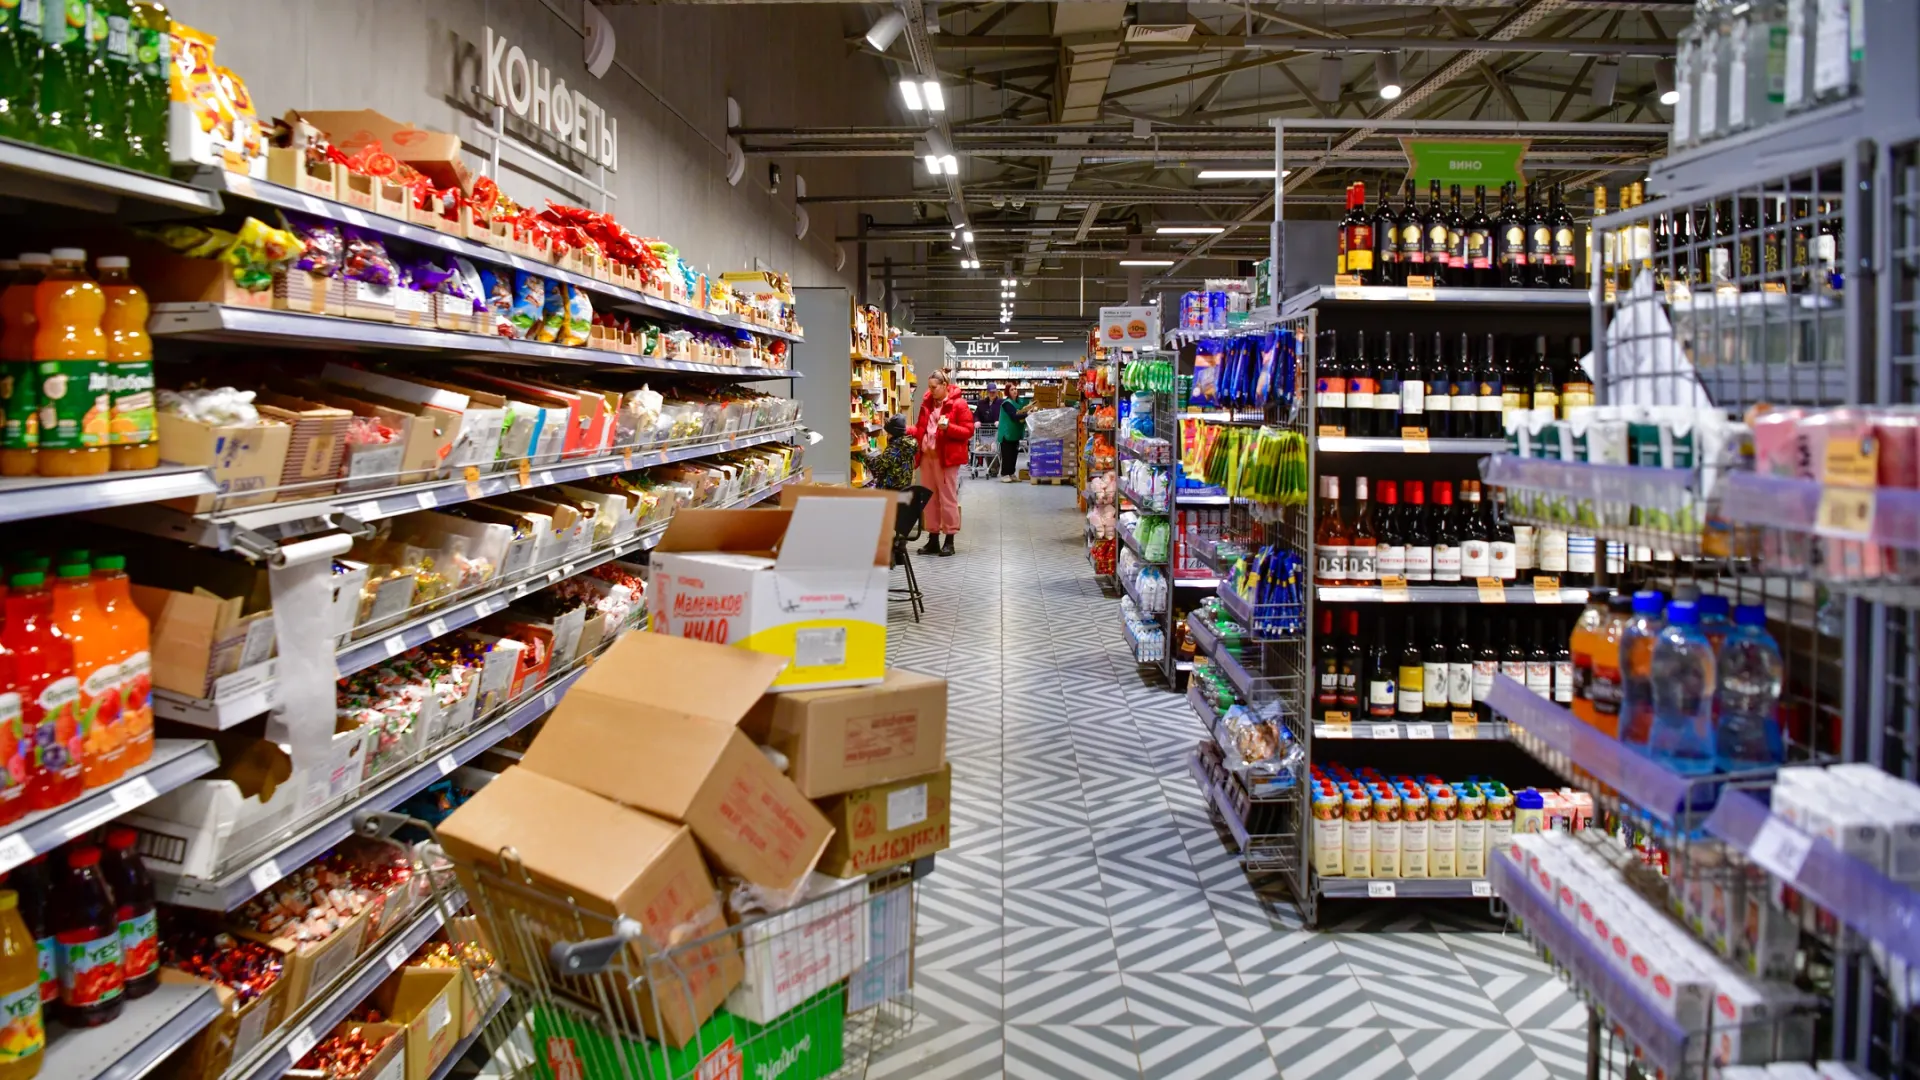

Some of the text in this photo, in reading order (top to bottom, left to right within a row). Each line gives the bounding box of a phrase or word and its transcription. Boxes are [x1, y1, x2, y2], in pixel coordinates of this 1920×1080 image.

[482, 25, 618, 173] КОНФЕТЫ
[1449, 160, 1482, 171] ВИНО
[966, 341, 1000, 354] ДЕТИ
[673, 592, 743, 617] Маленькое
